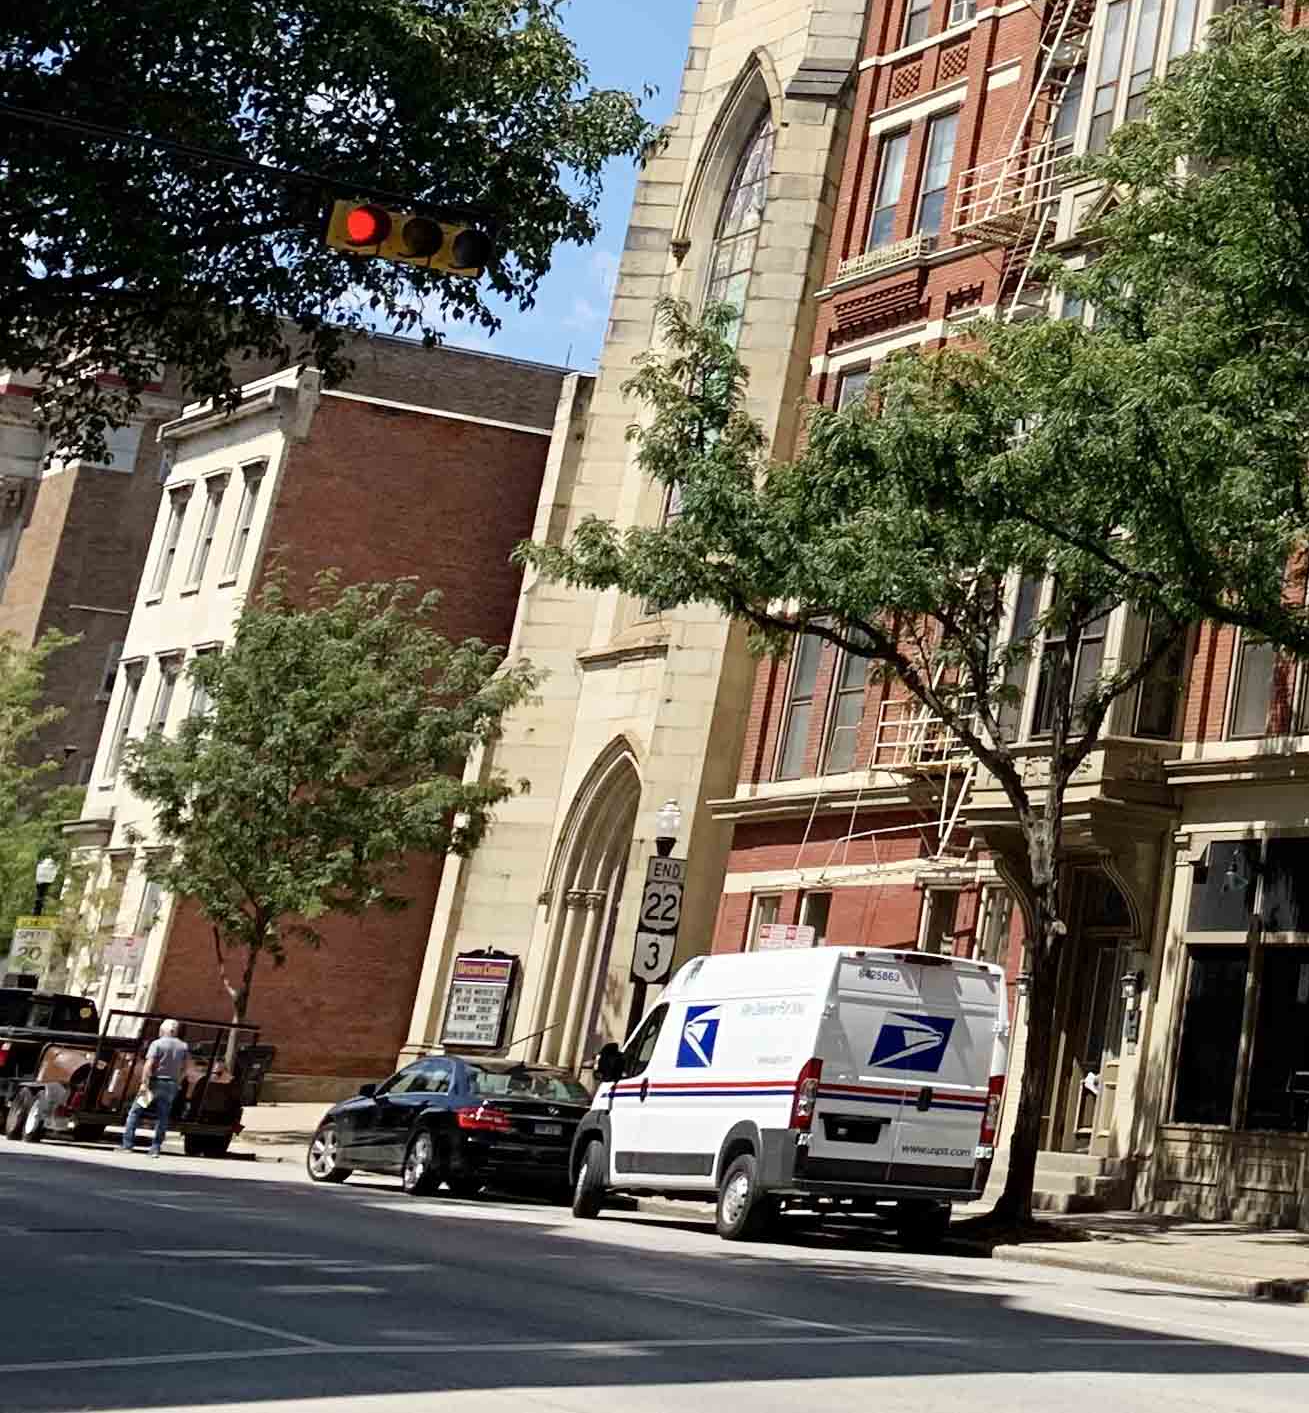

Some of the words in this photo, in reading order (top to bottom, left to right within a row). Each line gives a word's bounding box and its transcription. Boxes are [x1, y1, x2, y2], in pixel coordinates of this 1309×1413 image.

[654, 862, 681, 879] END
[644, 892, 677, 921] 22
[644, 942, 660, 970] 3
